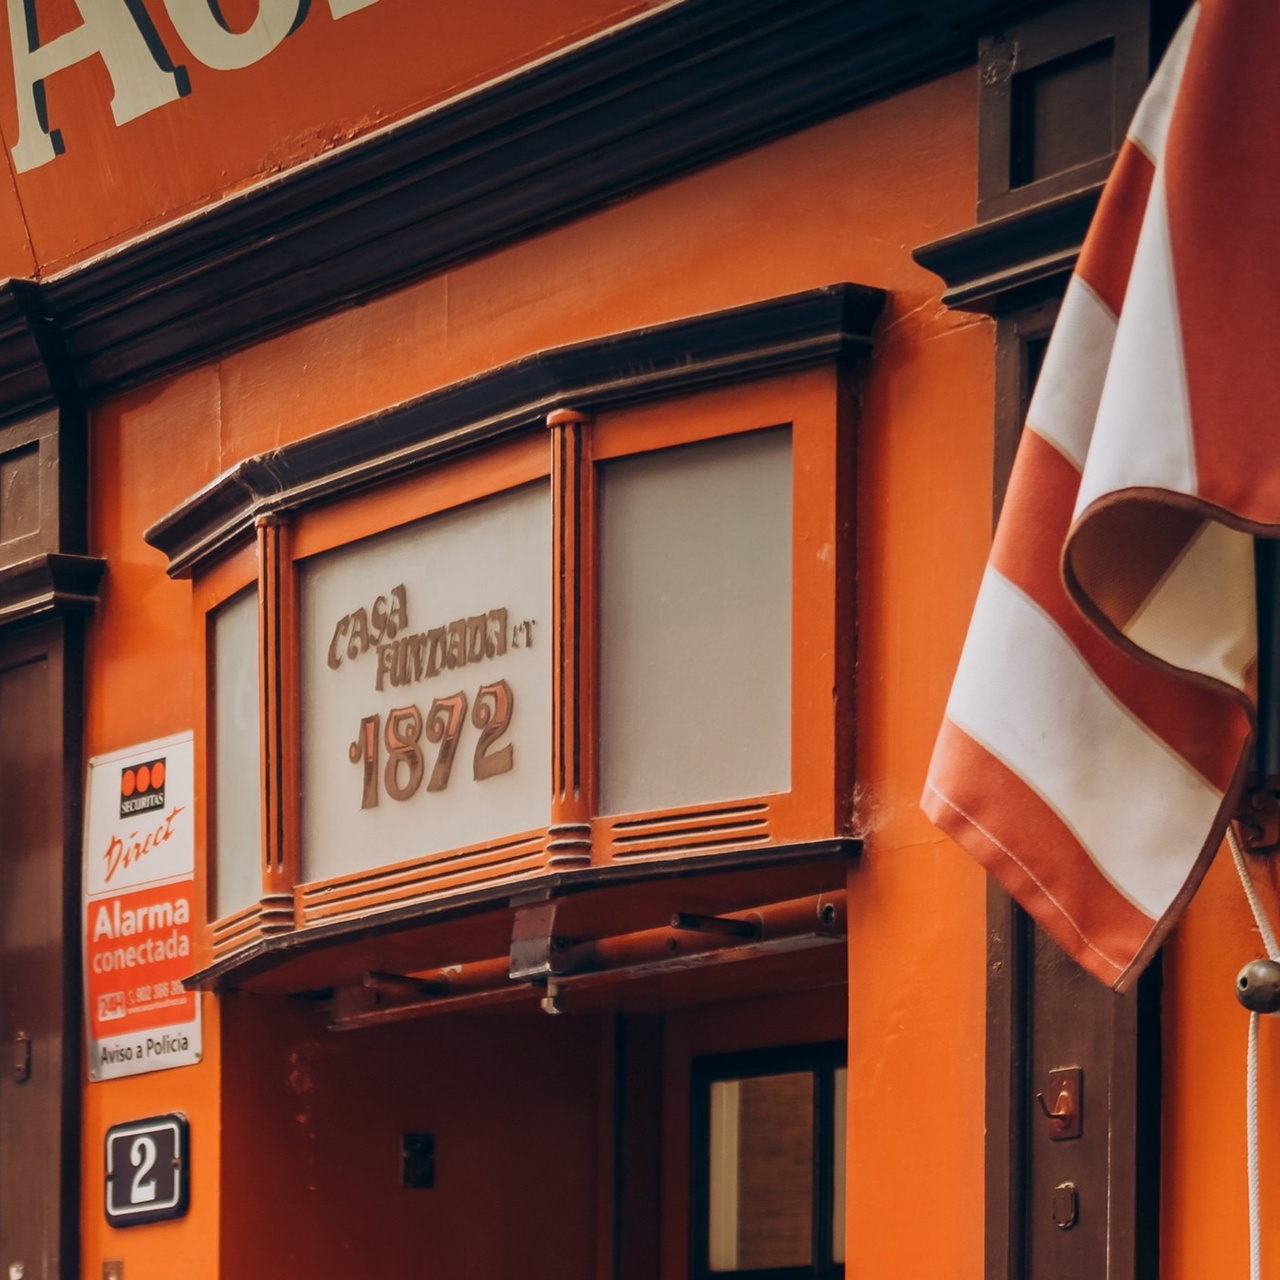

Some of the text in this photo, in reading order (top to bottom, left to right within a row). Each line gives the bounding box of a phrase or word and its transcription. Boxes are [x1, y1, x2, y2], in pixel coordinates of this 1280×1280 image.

[327, 583, 409, 670] CASA
[375, 607, 508, 692] FUNDADA
[348, 678, 514, 811] 1872
[121, 792, 164, 815] SECURITAS
[104, 806, 187, 884] Direct
[93, 898, 190, 943] Alarma
[93, 929, 190, 974] conectada
[101, 1032, 189, 1066] Aviso a Policía
[130, 1136, 157, 1205] 2
